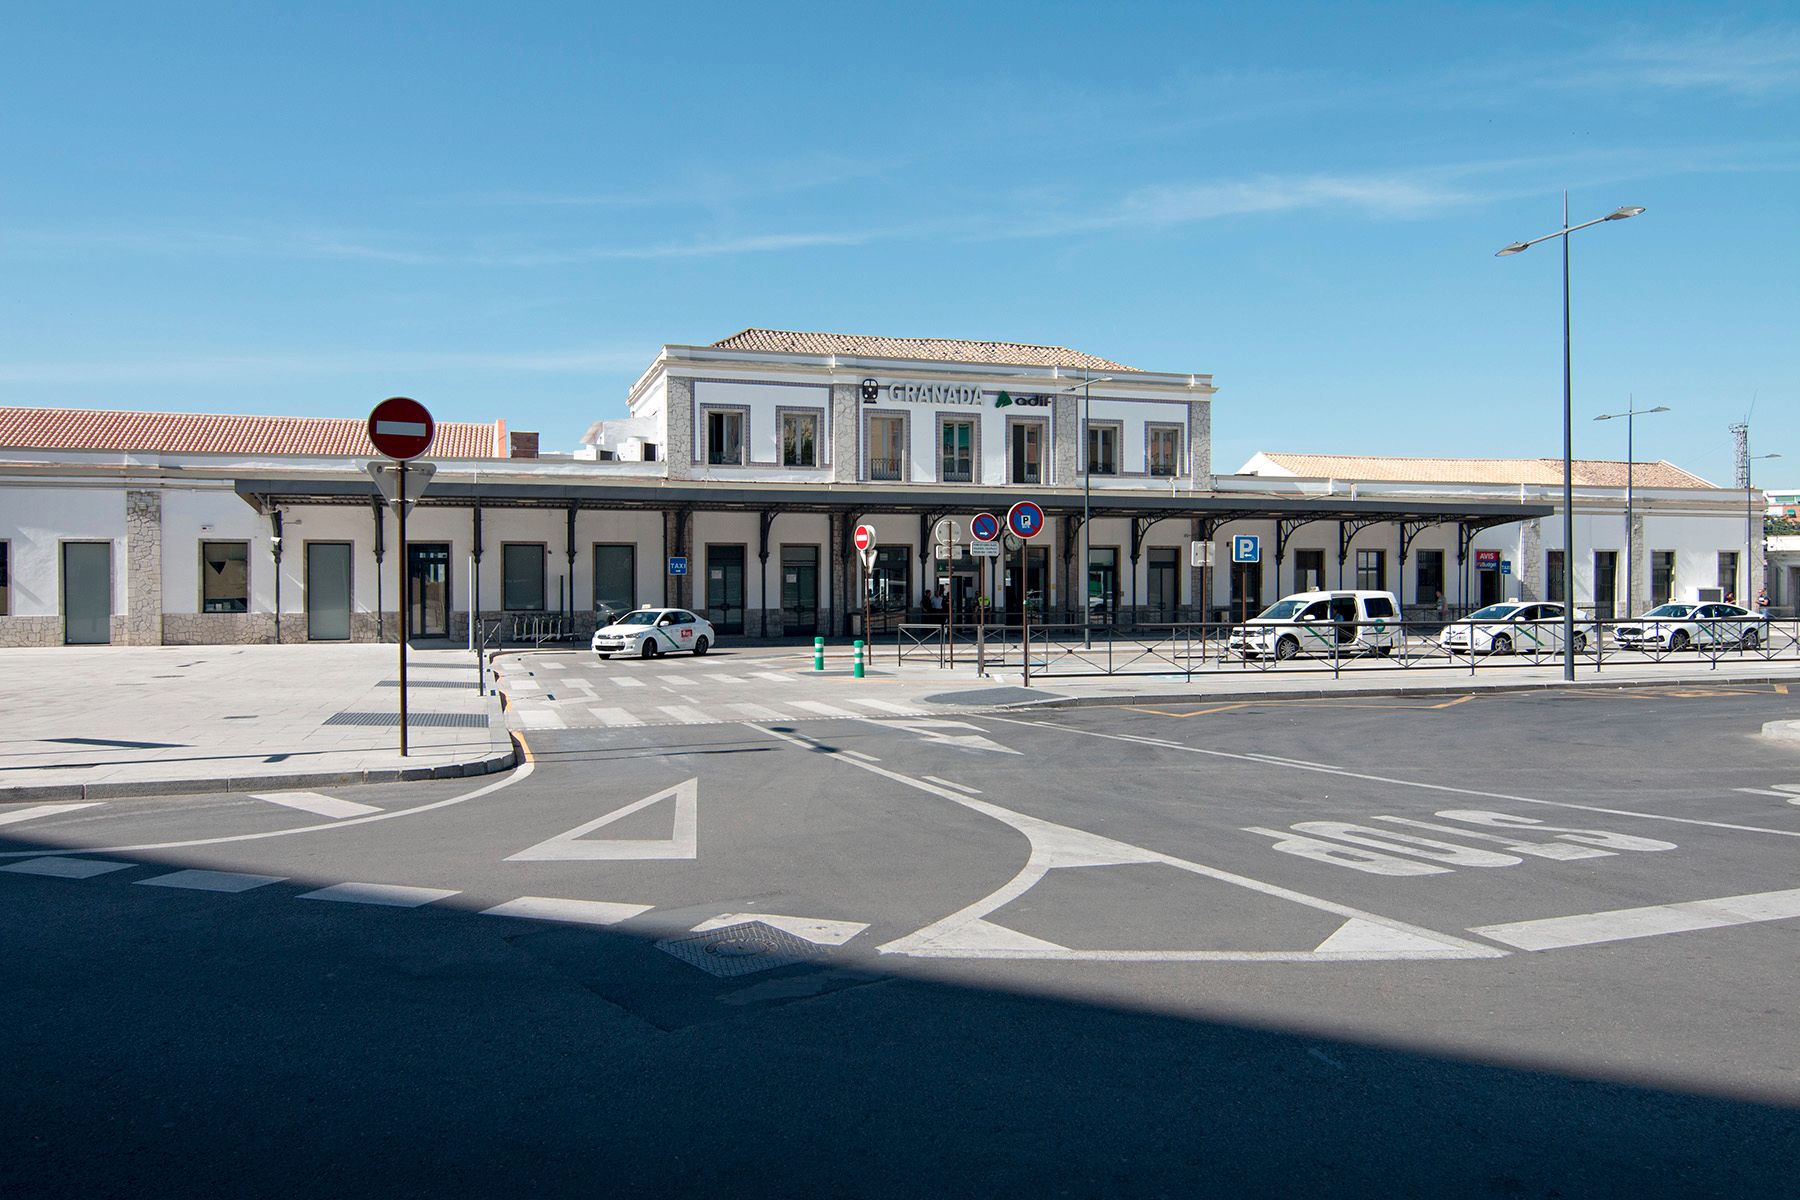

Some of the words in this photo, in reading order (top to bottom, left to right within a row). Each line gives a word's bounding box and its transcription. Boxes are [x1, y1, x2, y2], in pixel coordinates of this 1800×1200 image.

[888, 382, 984, 406] GRANADA
[1015, 395, 1052, 407] adif
[1240, 540, 1253, 558] P
[1240, 809, 1678, 877] STOP
